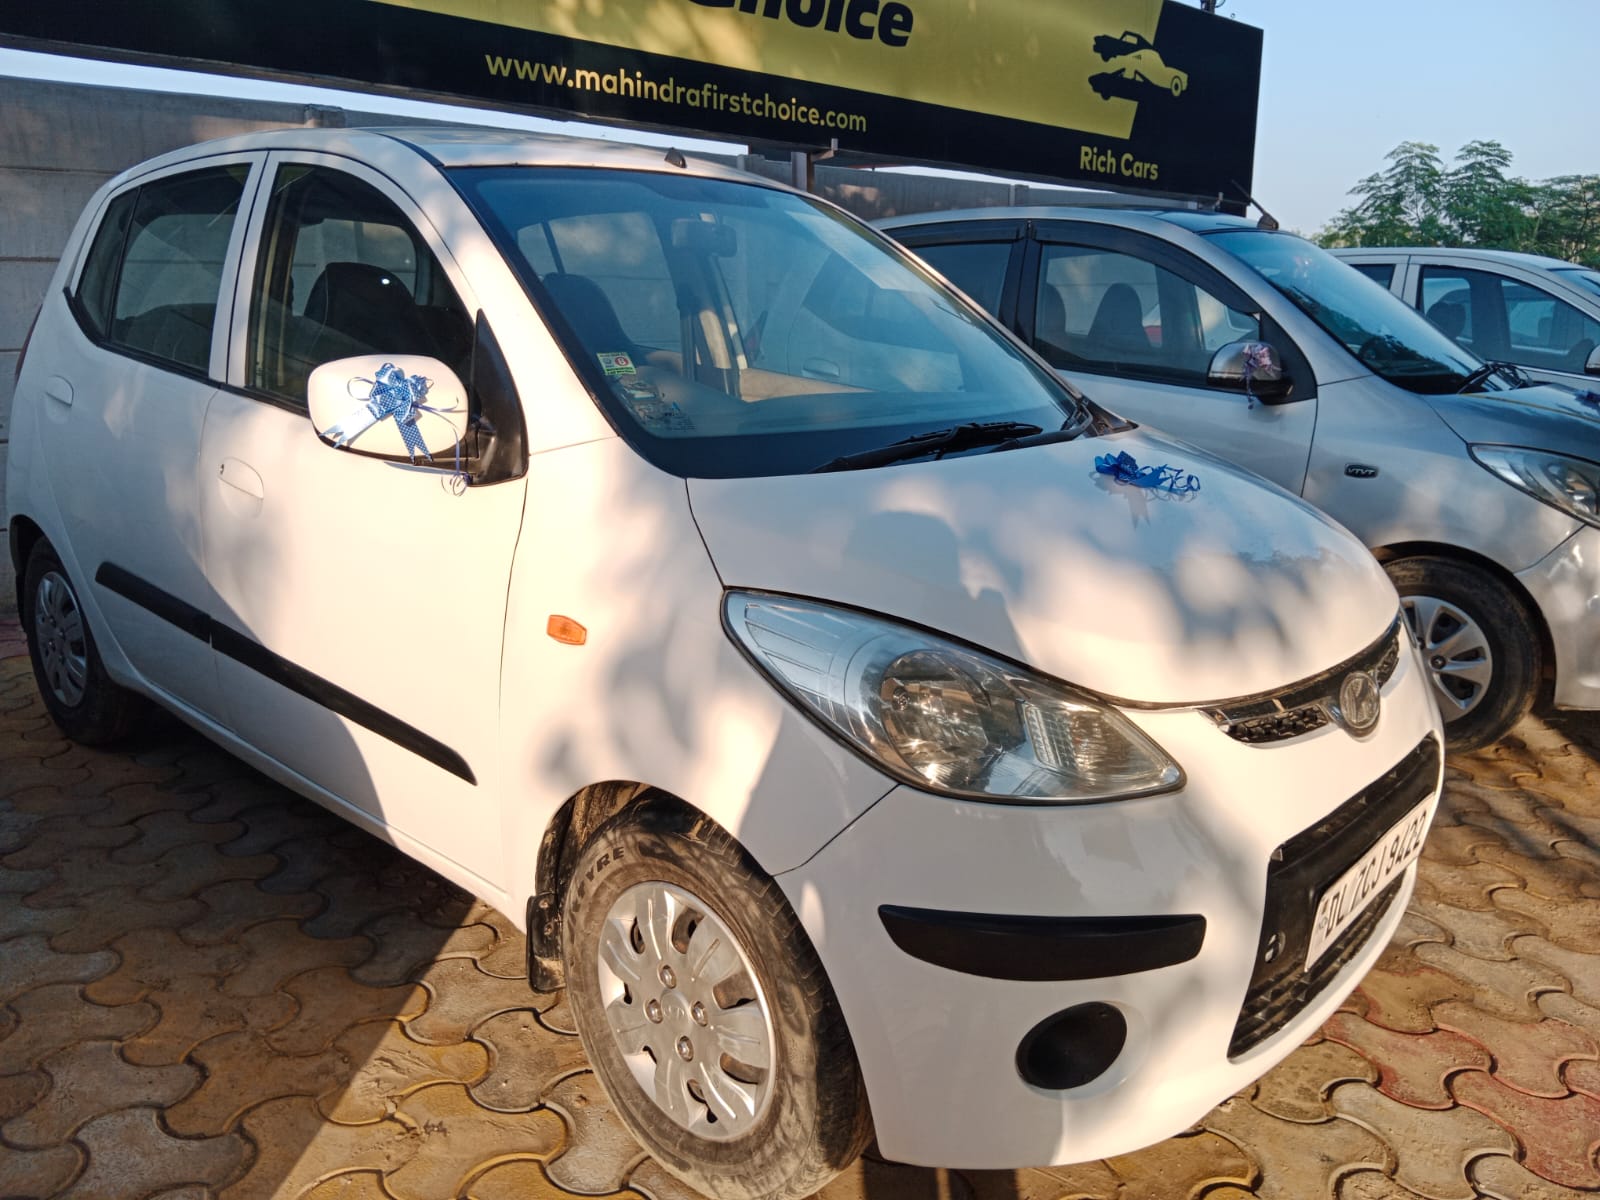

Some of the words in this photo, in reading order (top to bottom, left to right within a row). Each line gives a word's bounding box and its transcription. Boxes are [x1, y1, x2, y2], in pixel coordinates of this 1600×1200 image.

[688, 0, 914, 47] oice
[485, 53, 868, 133] www.mahindrafirstchoice.com
[1079, 145, 1117, 174] Rich
[1120, 152, 1159, 180] Cars
[1325, 884, 1348, 939] DL
[1350, 845, 1389, 911] 7CJ
[1385, 809, 1428, 876] 9422
